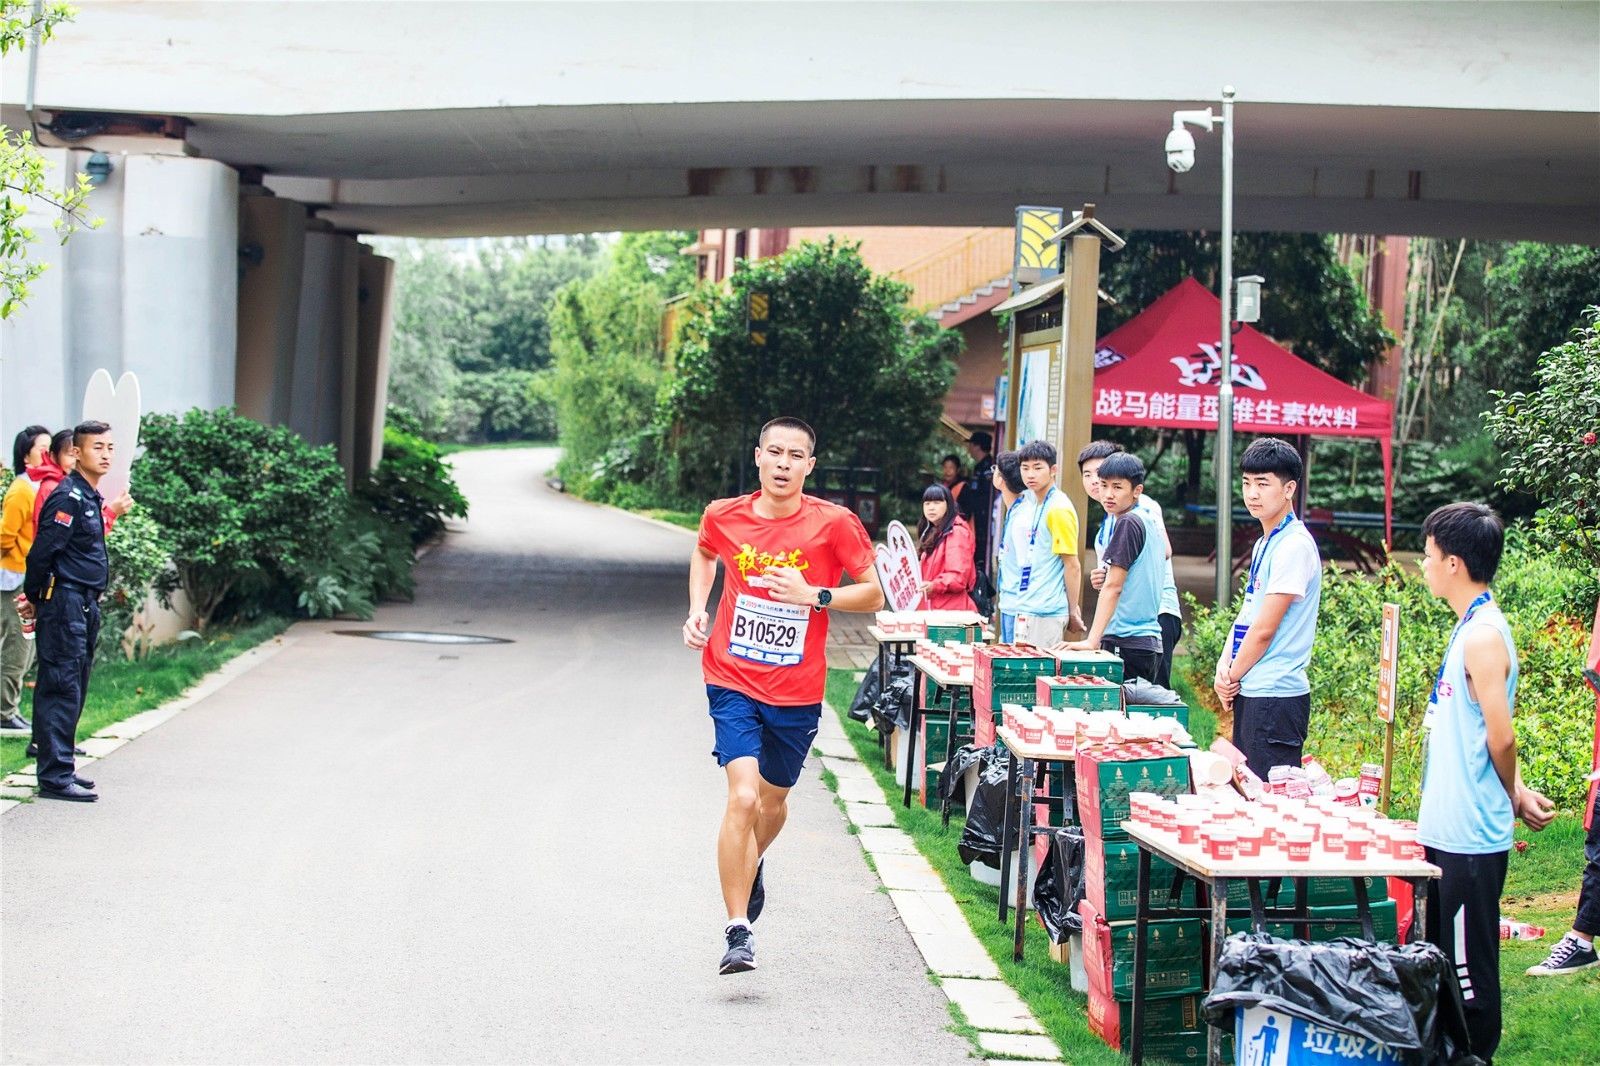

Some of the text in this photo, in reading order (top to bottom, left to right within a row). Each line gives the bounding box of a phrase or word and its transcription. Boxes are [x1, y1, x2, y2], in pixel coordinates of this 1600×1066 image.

[1095, 389, 1358, 430] 战马能量型维生素饮料
[734, 614, 797, 648] B10529
[1302, 1023, 1404, 1063] 垃圾不
